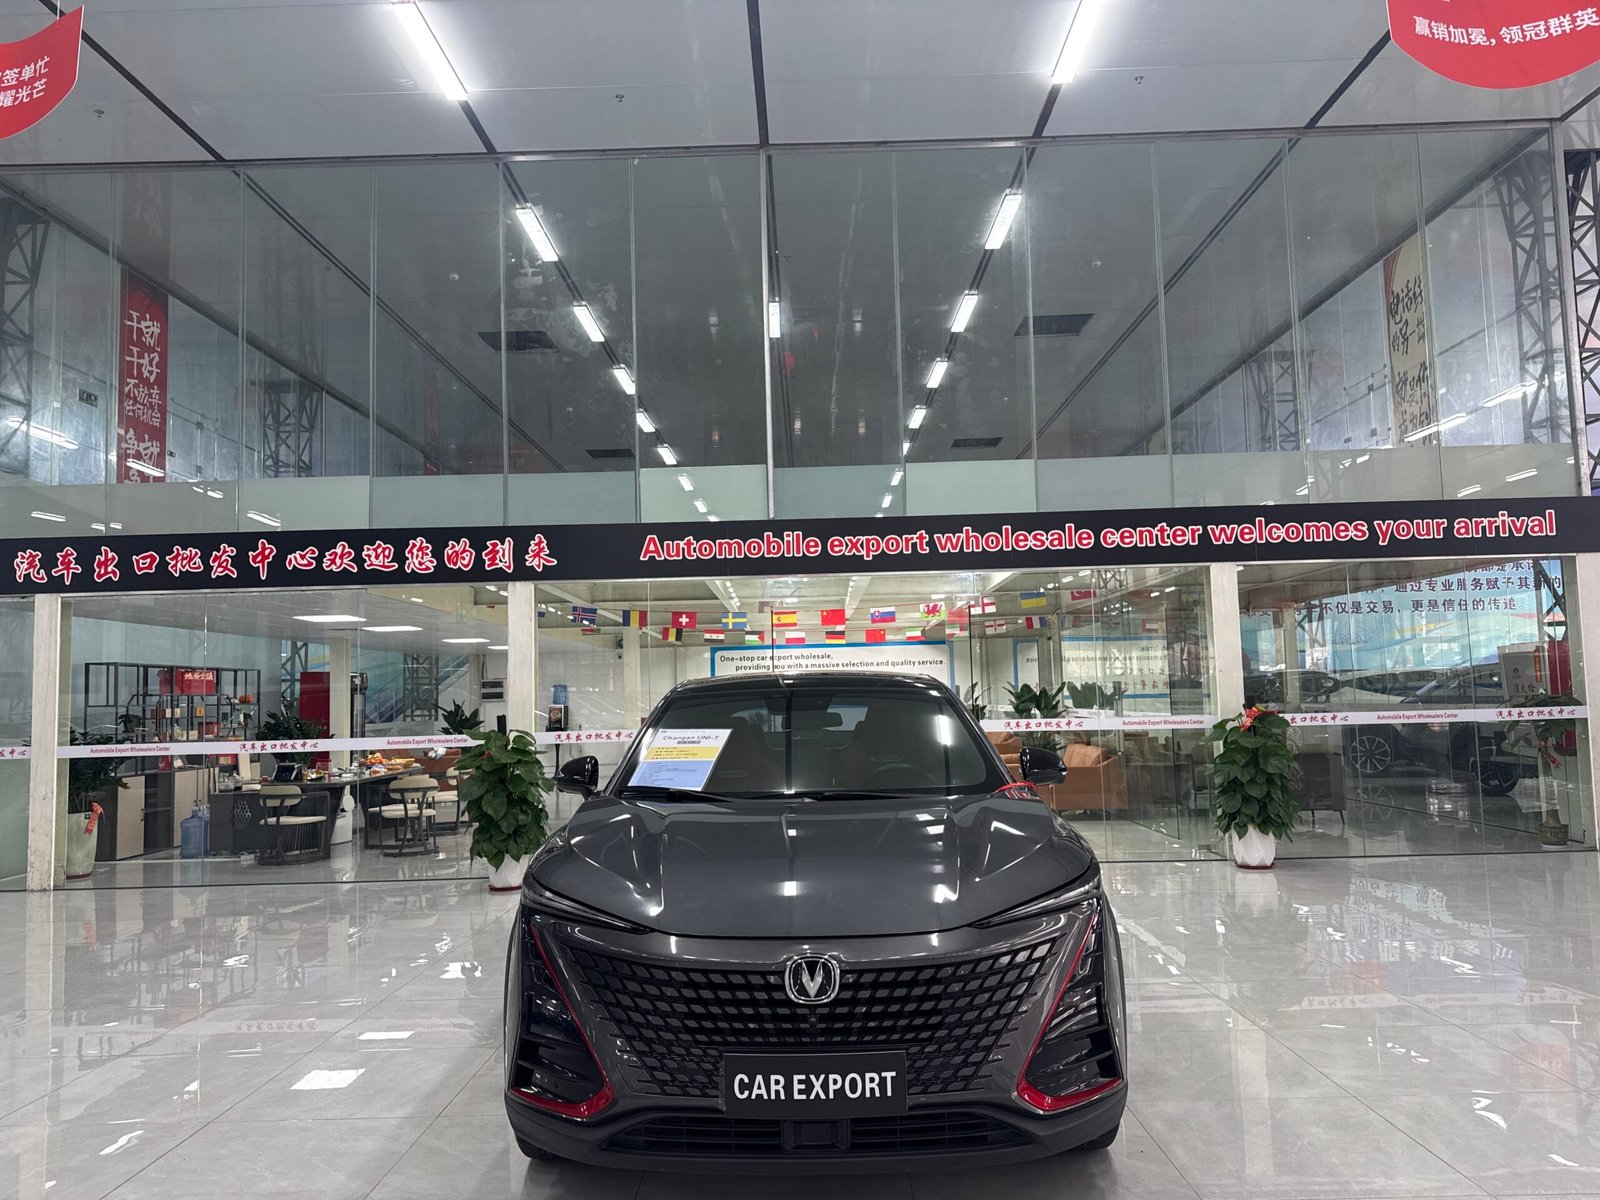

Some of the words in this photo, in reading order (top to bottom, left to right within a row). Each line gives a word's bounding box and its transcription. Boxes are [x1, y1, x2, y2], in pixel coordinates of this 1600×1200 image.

[0, 56, 50, 87] 签单忙
[640, 531, 821, 560] Automobile
[828, 530, 928, 561] export
[934, 523, 1095, 553] wholesale
[1100, 522, 1202, 549] center
[1208, 517, 1369, 546] welcomes
[1375, 518, 1448, 546] your
[1454, 510, 1556, 538] arrival
[14, 534, 557, 585] 汽车出口批发中心欢迎您的到来
[720, 655, 755, 663] One-stop
[794, 653, 833, 661] wholesale,
[735, 662, 770, 671] providing
[891, 659, 916, 667] quality
[1496, 708, 1576, 719] 汽车出口批发中心
[1004, 721, 1083, 730] 汽车出口批发中心
[554, 731, 633, 742] 汽车出口批发中心
[240, 741, 318, 752] 汽车出口批发中心
[734, 1073, 785, 1100] CAR
[793, 1072, 897, 1100] EXPORT
